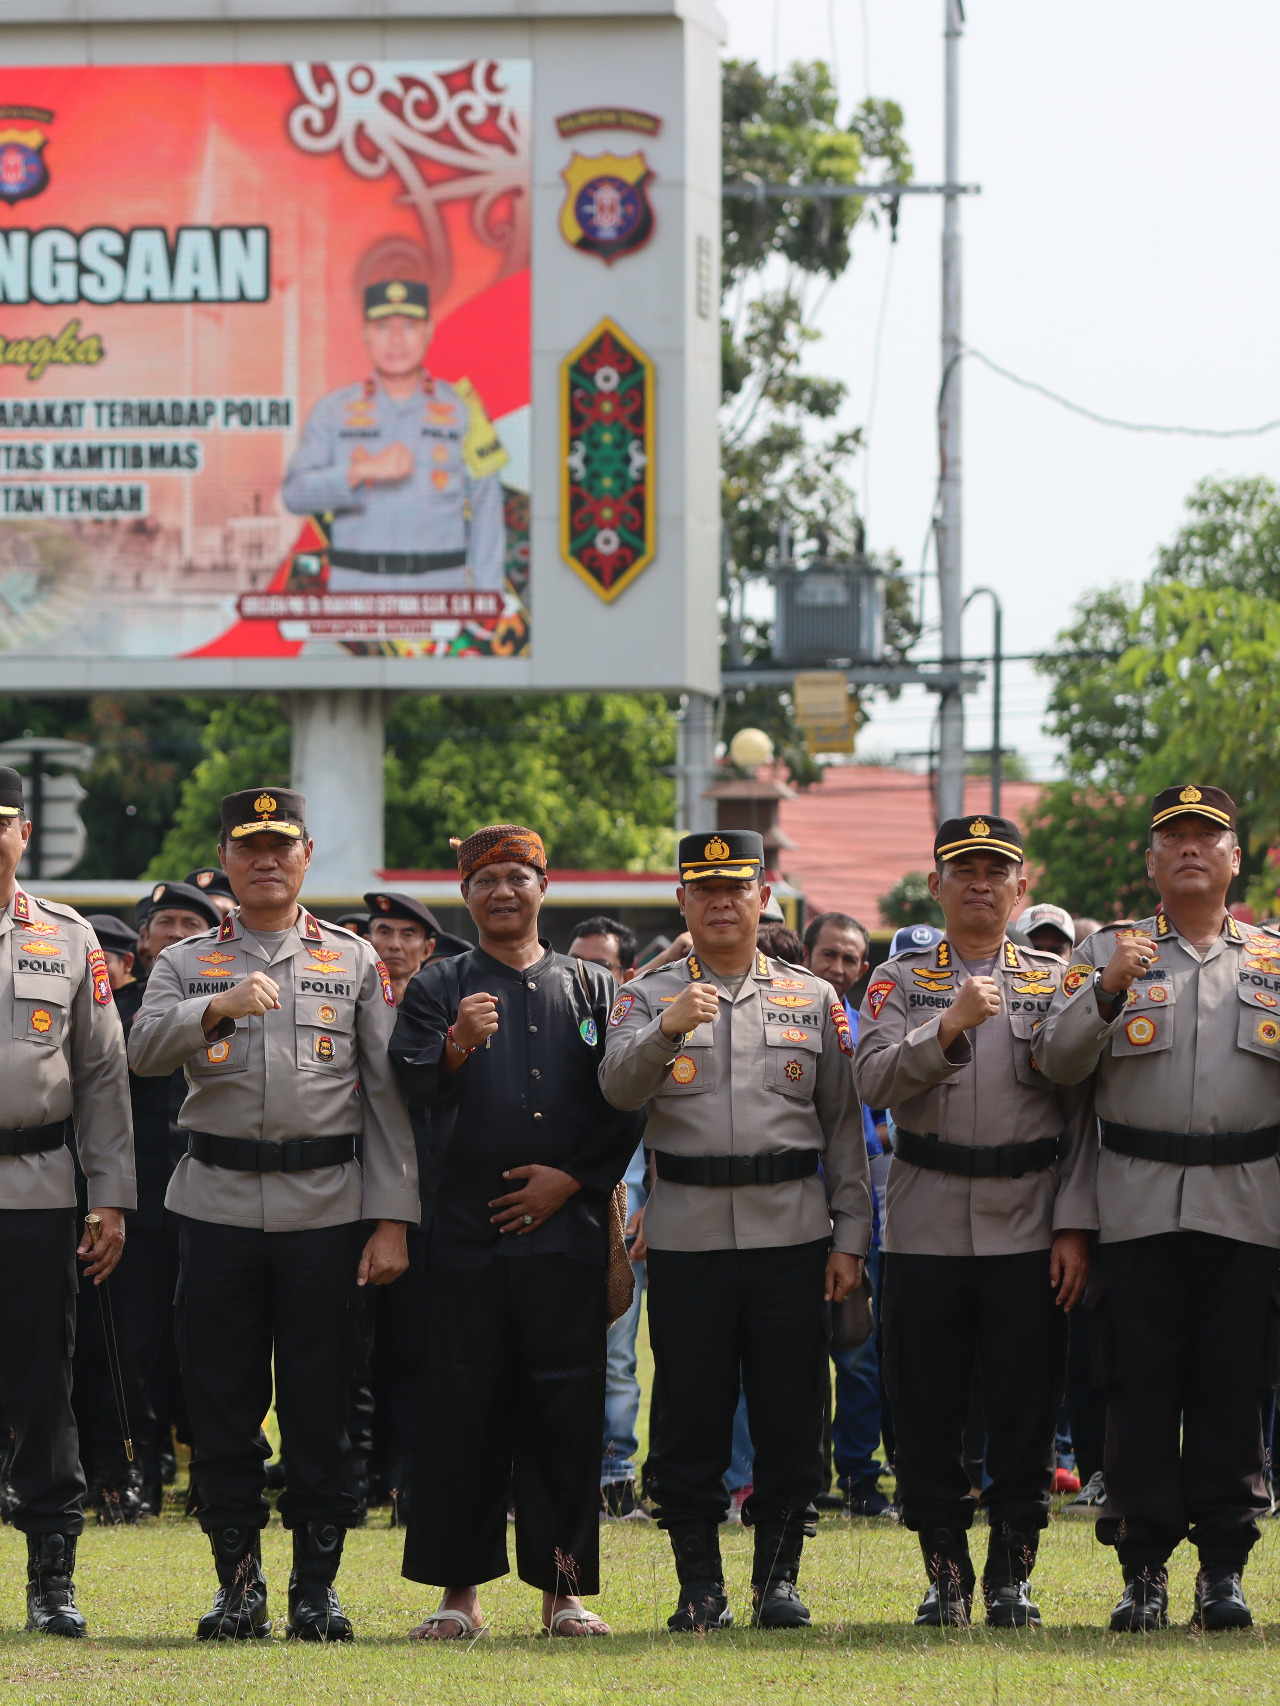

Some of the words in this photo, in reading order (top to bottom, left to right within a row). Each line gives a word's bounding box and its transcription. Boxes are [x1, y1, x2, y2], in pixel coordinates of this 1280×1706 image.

[94, 402, 216, 428] TERHADAP
[225, 401, 291, 427] POLRI
[53, 443, 198, 470] KAMTIBMAS
[53, 486, 143, 513] TENGAH
[18, 958, 66, 975] POLRI
[188, 981, 239, 995] RAKHMA
[301, 980, 351, 997] POLRI
[767, 1011, 818, 1026] POLRI
